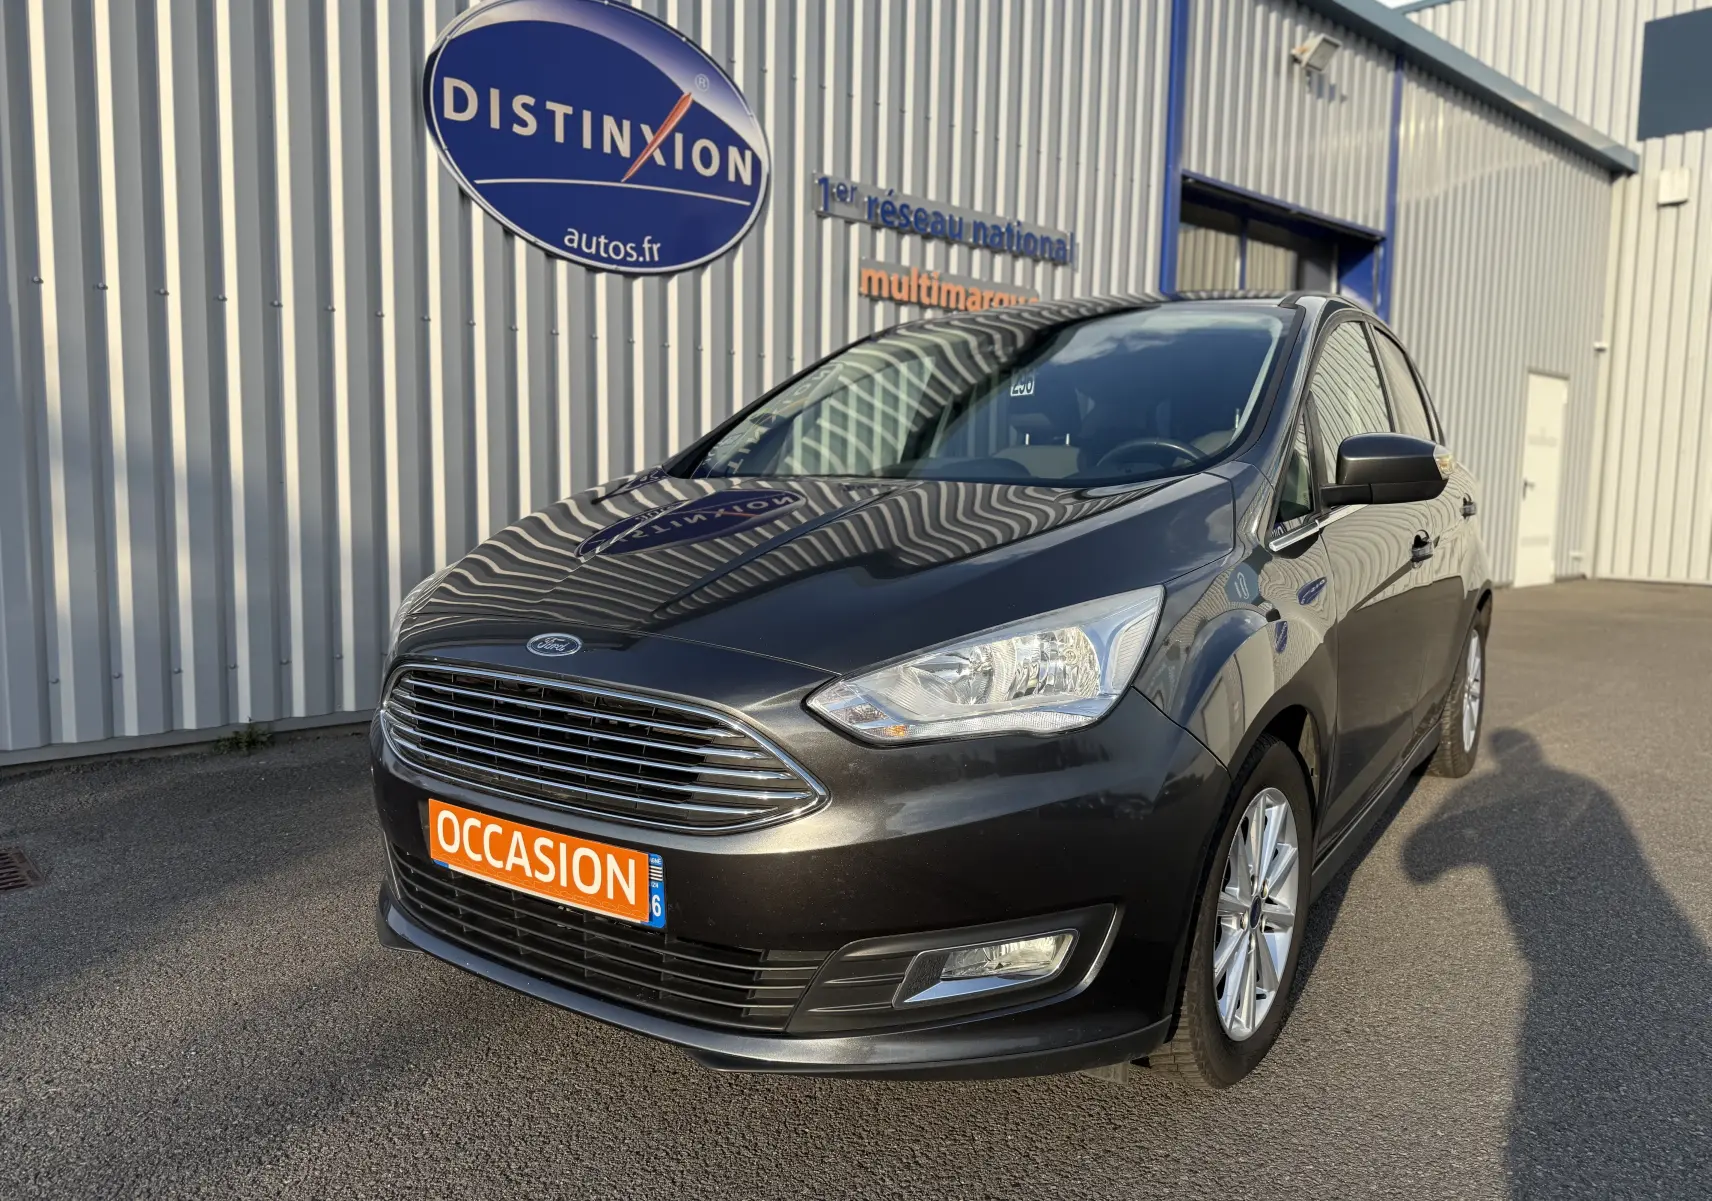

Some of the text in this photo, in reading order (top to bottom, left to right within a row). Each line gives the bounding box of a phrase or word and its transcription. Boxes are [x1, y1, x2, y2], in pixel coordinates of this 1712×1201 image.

[443, 77, 752, 186] DISTINXION
[564, 228, 661, 262] autos.fr
[866, 188, 963, 240] réseau
[972, 220, 1074, 265] national
[537, 637, 570, 652] Ford
[437, 809, 635, 905] OCCASION
